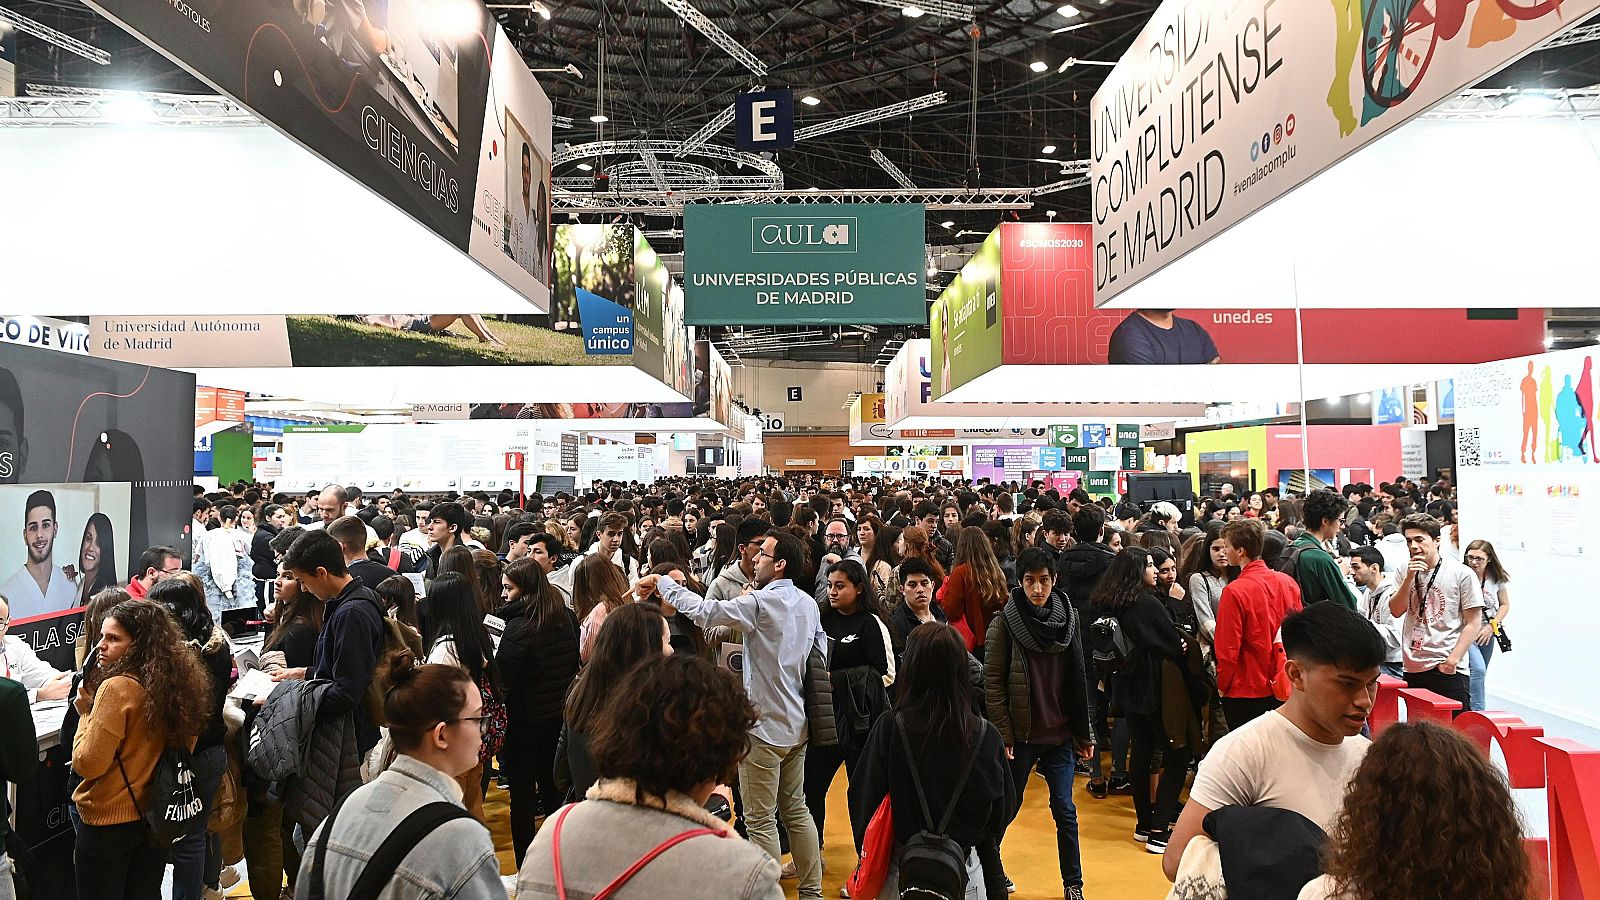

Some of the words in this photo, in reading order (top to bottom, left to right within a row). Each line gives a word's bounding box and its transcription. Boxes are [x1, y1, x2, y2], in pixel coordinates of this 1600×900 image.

[1094, 0, 1229, 163] UNIVERSID
[1095, 0, 1284, 226] COMPLUTENSE
[752, 101, 777, 141] E
[361, 105, 459, 213] CIENCIAS
[1233, 144, 1296, 197] #venalacomplu
[1096, 229, 1118, 293] DE
[1124, 149, 1226, 274] MADRID
[1019, 239, 1084, 248] #SOMOS2030
[693, 273, 830, 286] UNIVERSIDADES
[834, 269, 918, 286] PÚBLICAS
[756, 291, 780, 305] DE
[785, 291, 854, 305] MADRID
[616, 315, 630, 323] un
[1213, 310, 1273, 325] uned.es
[104, 320, 186, 333] Universidad
[190, 318, 260, 333] Autónoma
[592, 326, 630, 336] campus
[28, 324, 50, 346] DE
[104, 337, 119, 350] de
[124, 337, 173, 350] Madrid
[588, 336, 630, 350] único
[791, 389, 799, 399] E
[413, 403, 425, 412] de
[428, 403, 462, 412] Madrid
[762, 414, 783, 430] io
